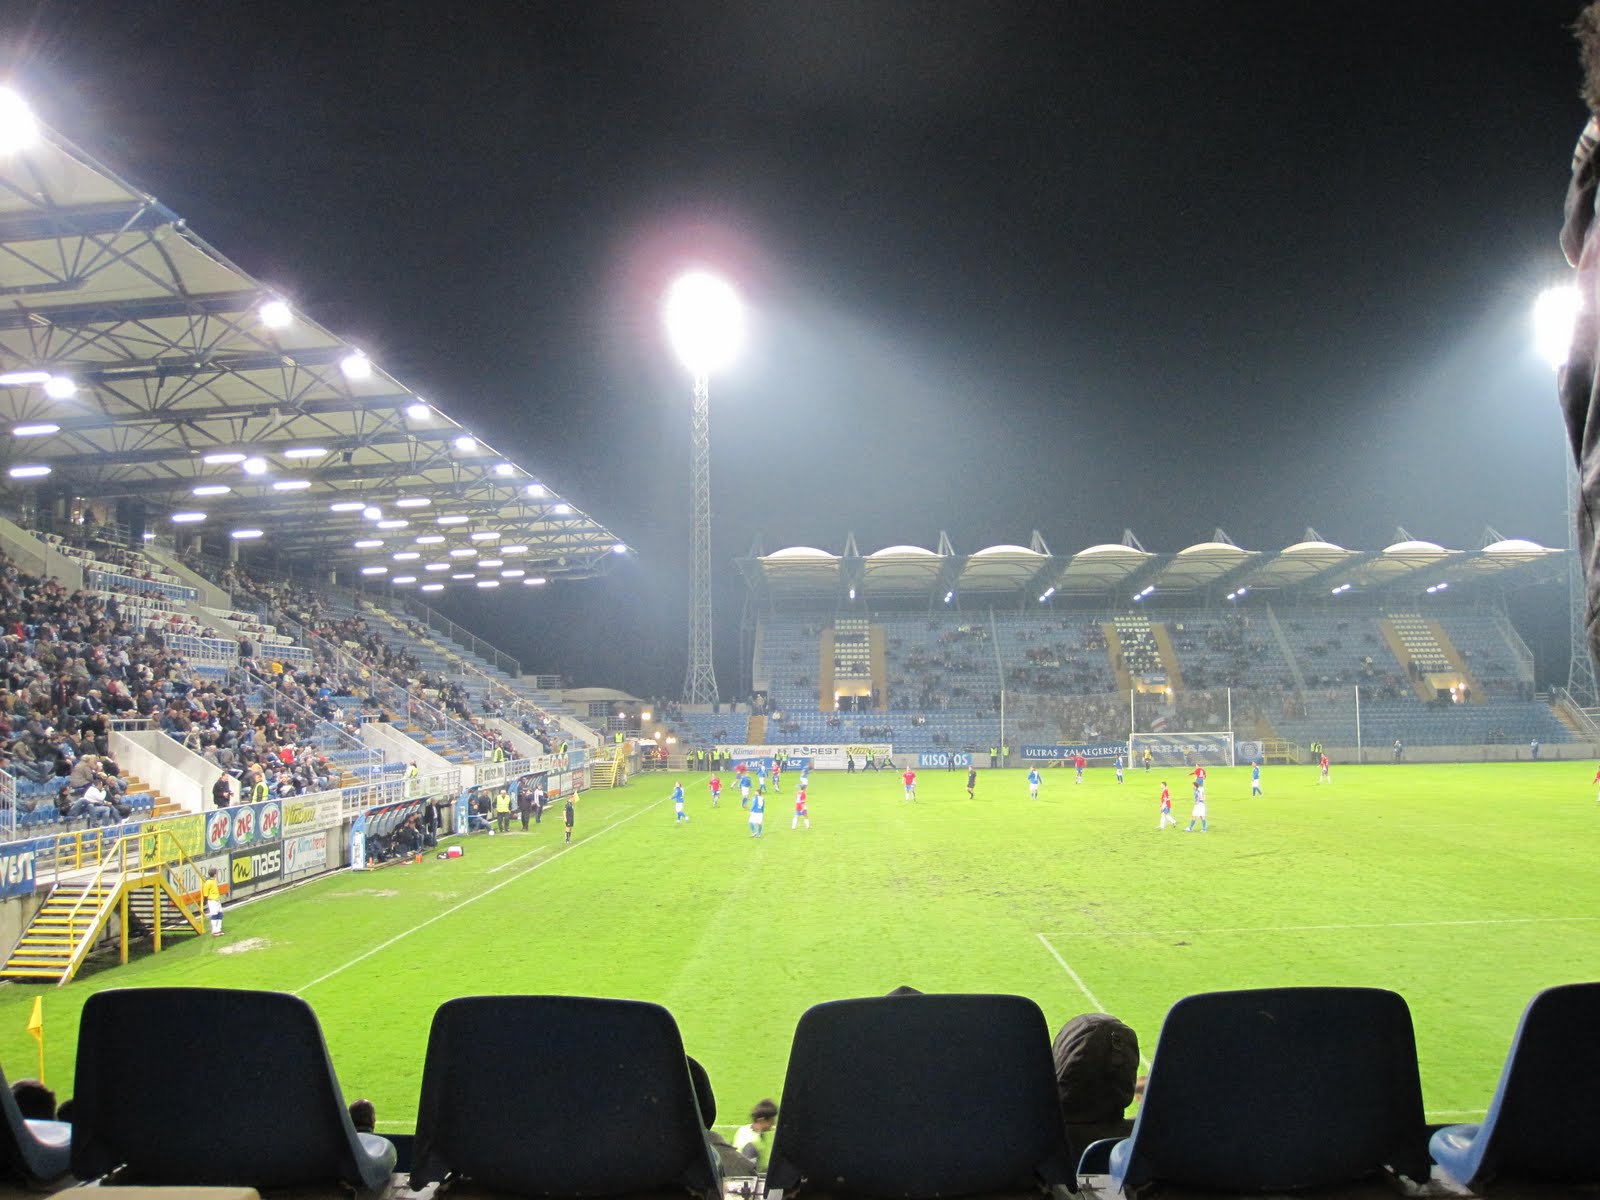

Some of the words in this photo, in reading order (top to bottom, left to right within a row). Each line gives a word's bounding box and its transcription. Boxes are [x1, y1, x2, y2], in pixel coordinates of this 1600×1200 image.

[793, 746, 840, 755] FOREST
[1025, 748, 1058, 757] ULTRAS
[211, 817, 228, 843] ave
[236, 812, 252, 838] ave
[262, 809, 279, 832] ave
[251, 849, 281, 878] mass
